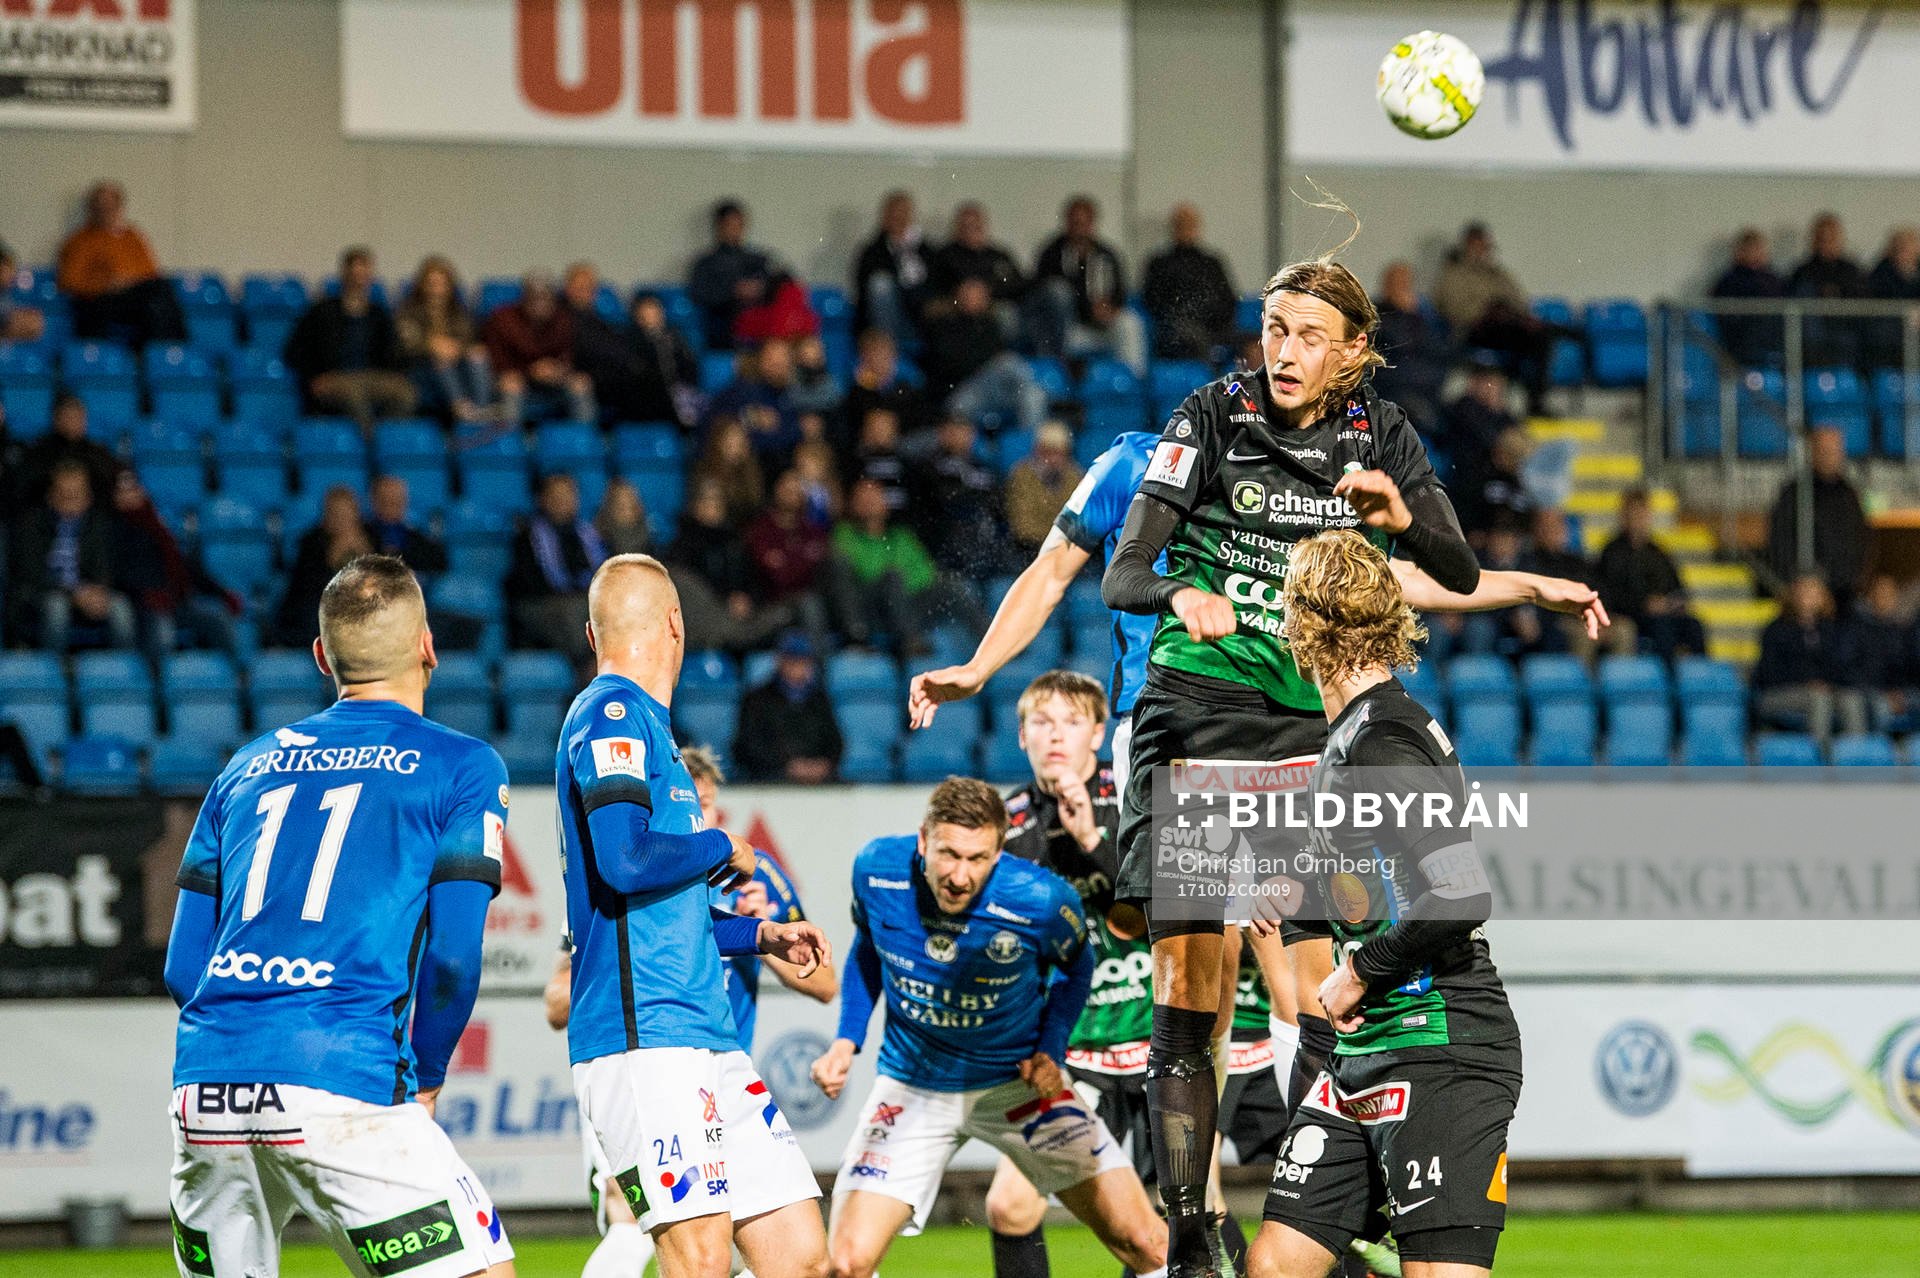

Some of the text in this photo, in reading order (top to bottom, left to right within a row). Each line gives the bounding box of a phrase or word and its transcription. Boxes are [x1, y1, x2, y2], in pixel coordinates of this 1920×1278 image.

[1268, 511, 1323, 527] Komplett
[245, 745, 421, 778] ERIKSBERG
[242, 782, 364, 923] 11
[1424, 852, 1477, 881] TIPS
[0, 854, 122, 948] at
[197, 1083, 286, 1114] BCA
[653, 1134, 683, 1166] 24
[1405, 1155, 1443, 1191] 24
